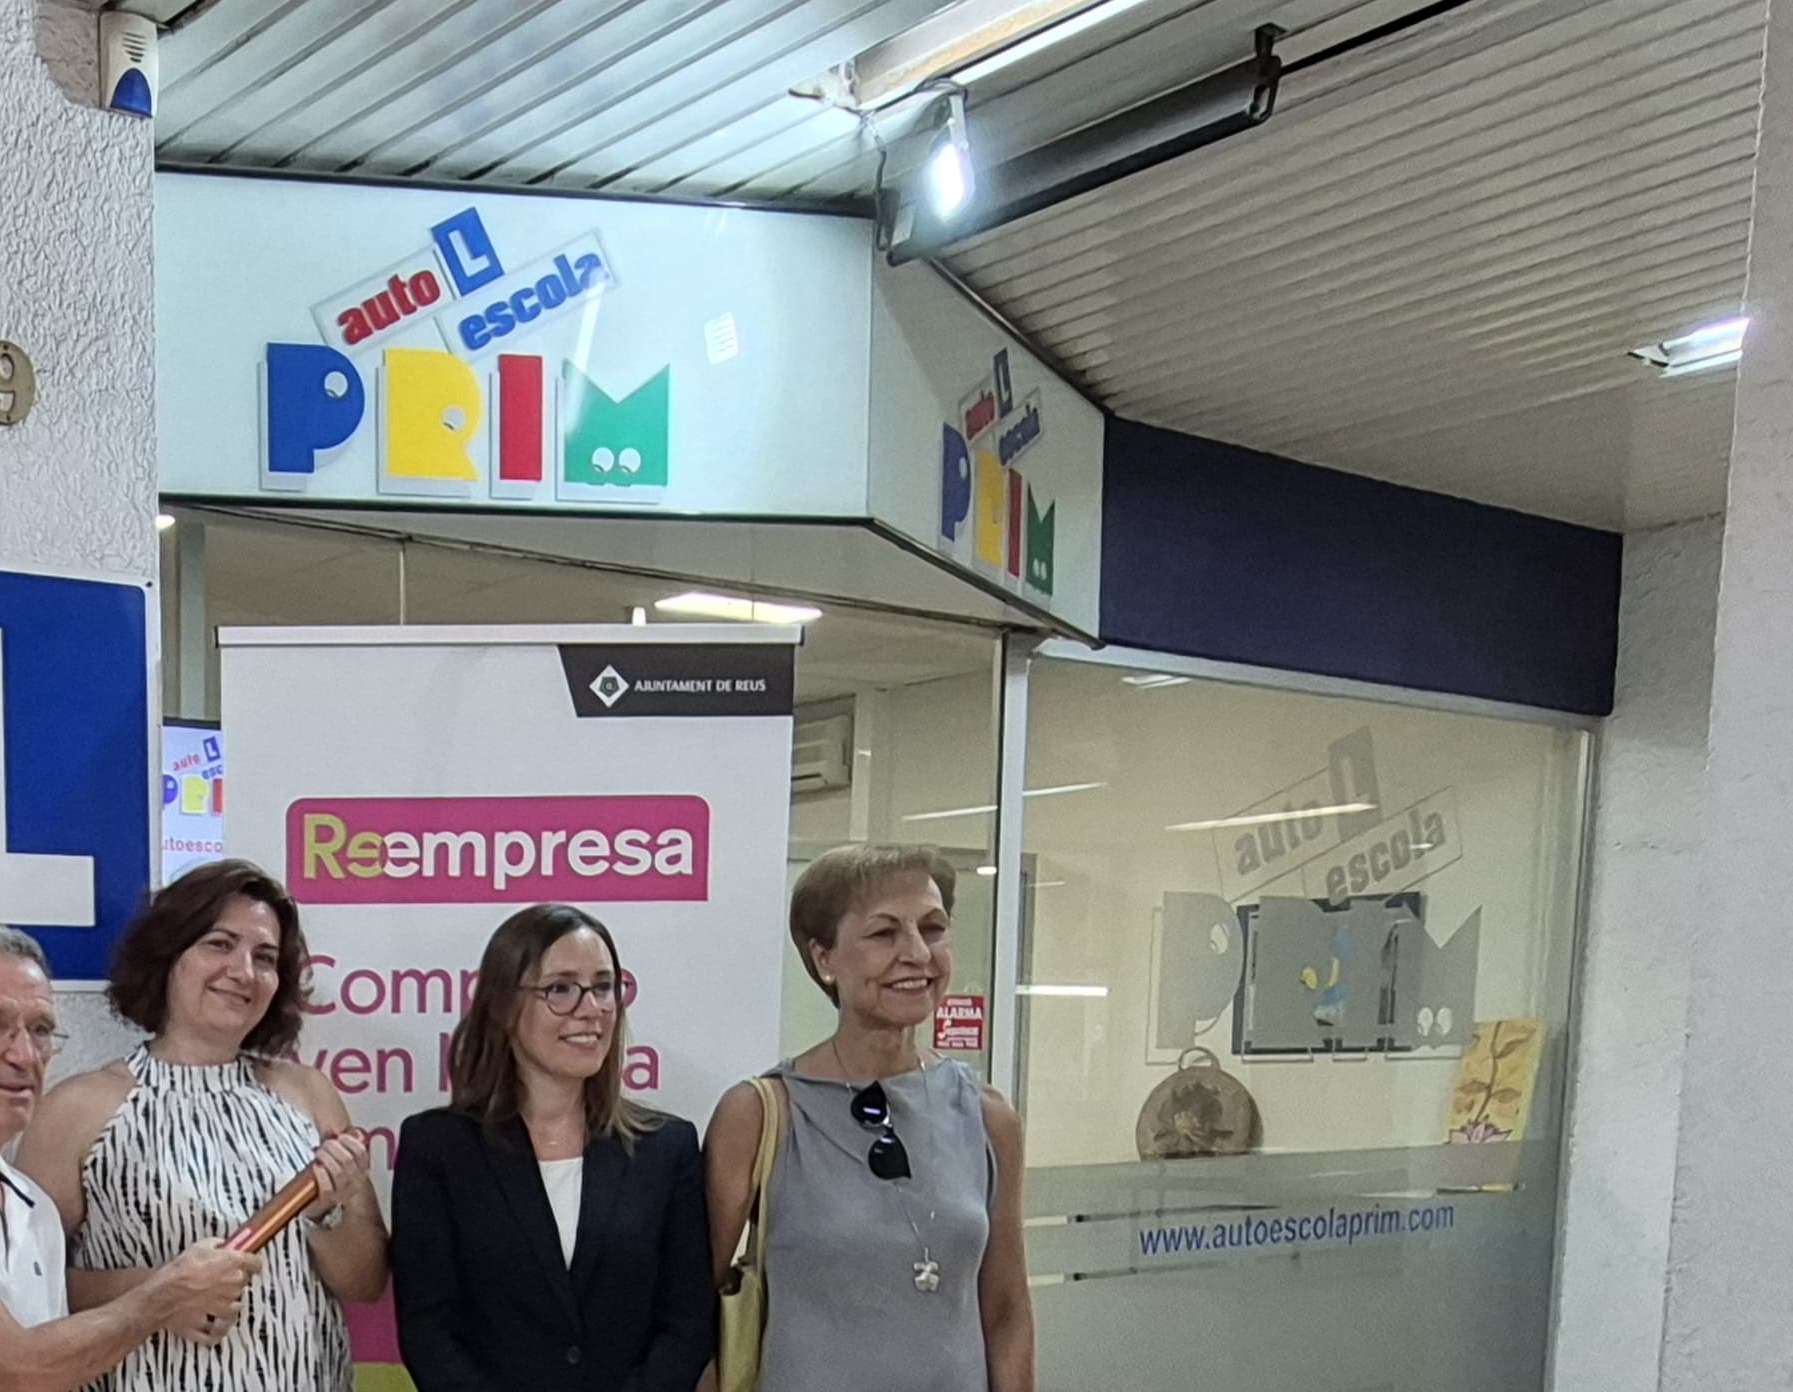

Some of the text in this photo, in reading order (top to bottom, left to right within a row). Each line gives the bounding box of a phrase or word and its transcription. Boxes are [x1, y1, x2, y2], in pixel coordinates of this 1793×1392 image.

[337, 229, 491, 346] auto L
[459, 253, 609, 351] escola
[267, 343, 670, 486] PRIM
[941, 421, 1056, 598] PRIM
[634, 679, 767, 693] AJUNTAMENT DE REUS
[304, 813, 694, 890] Reempresa
[1234, 801, 1324, 876] auto
[1326, 808, 1446, 906] escola
[1140, 1203, 1455, 1254] www.autoescolaprim.com
